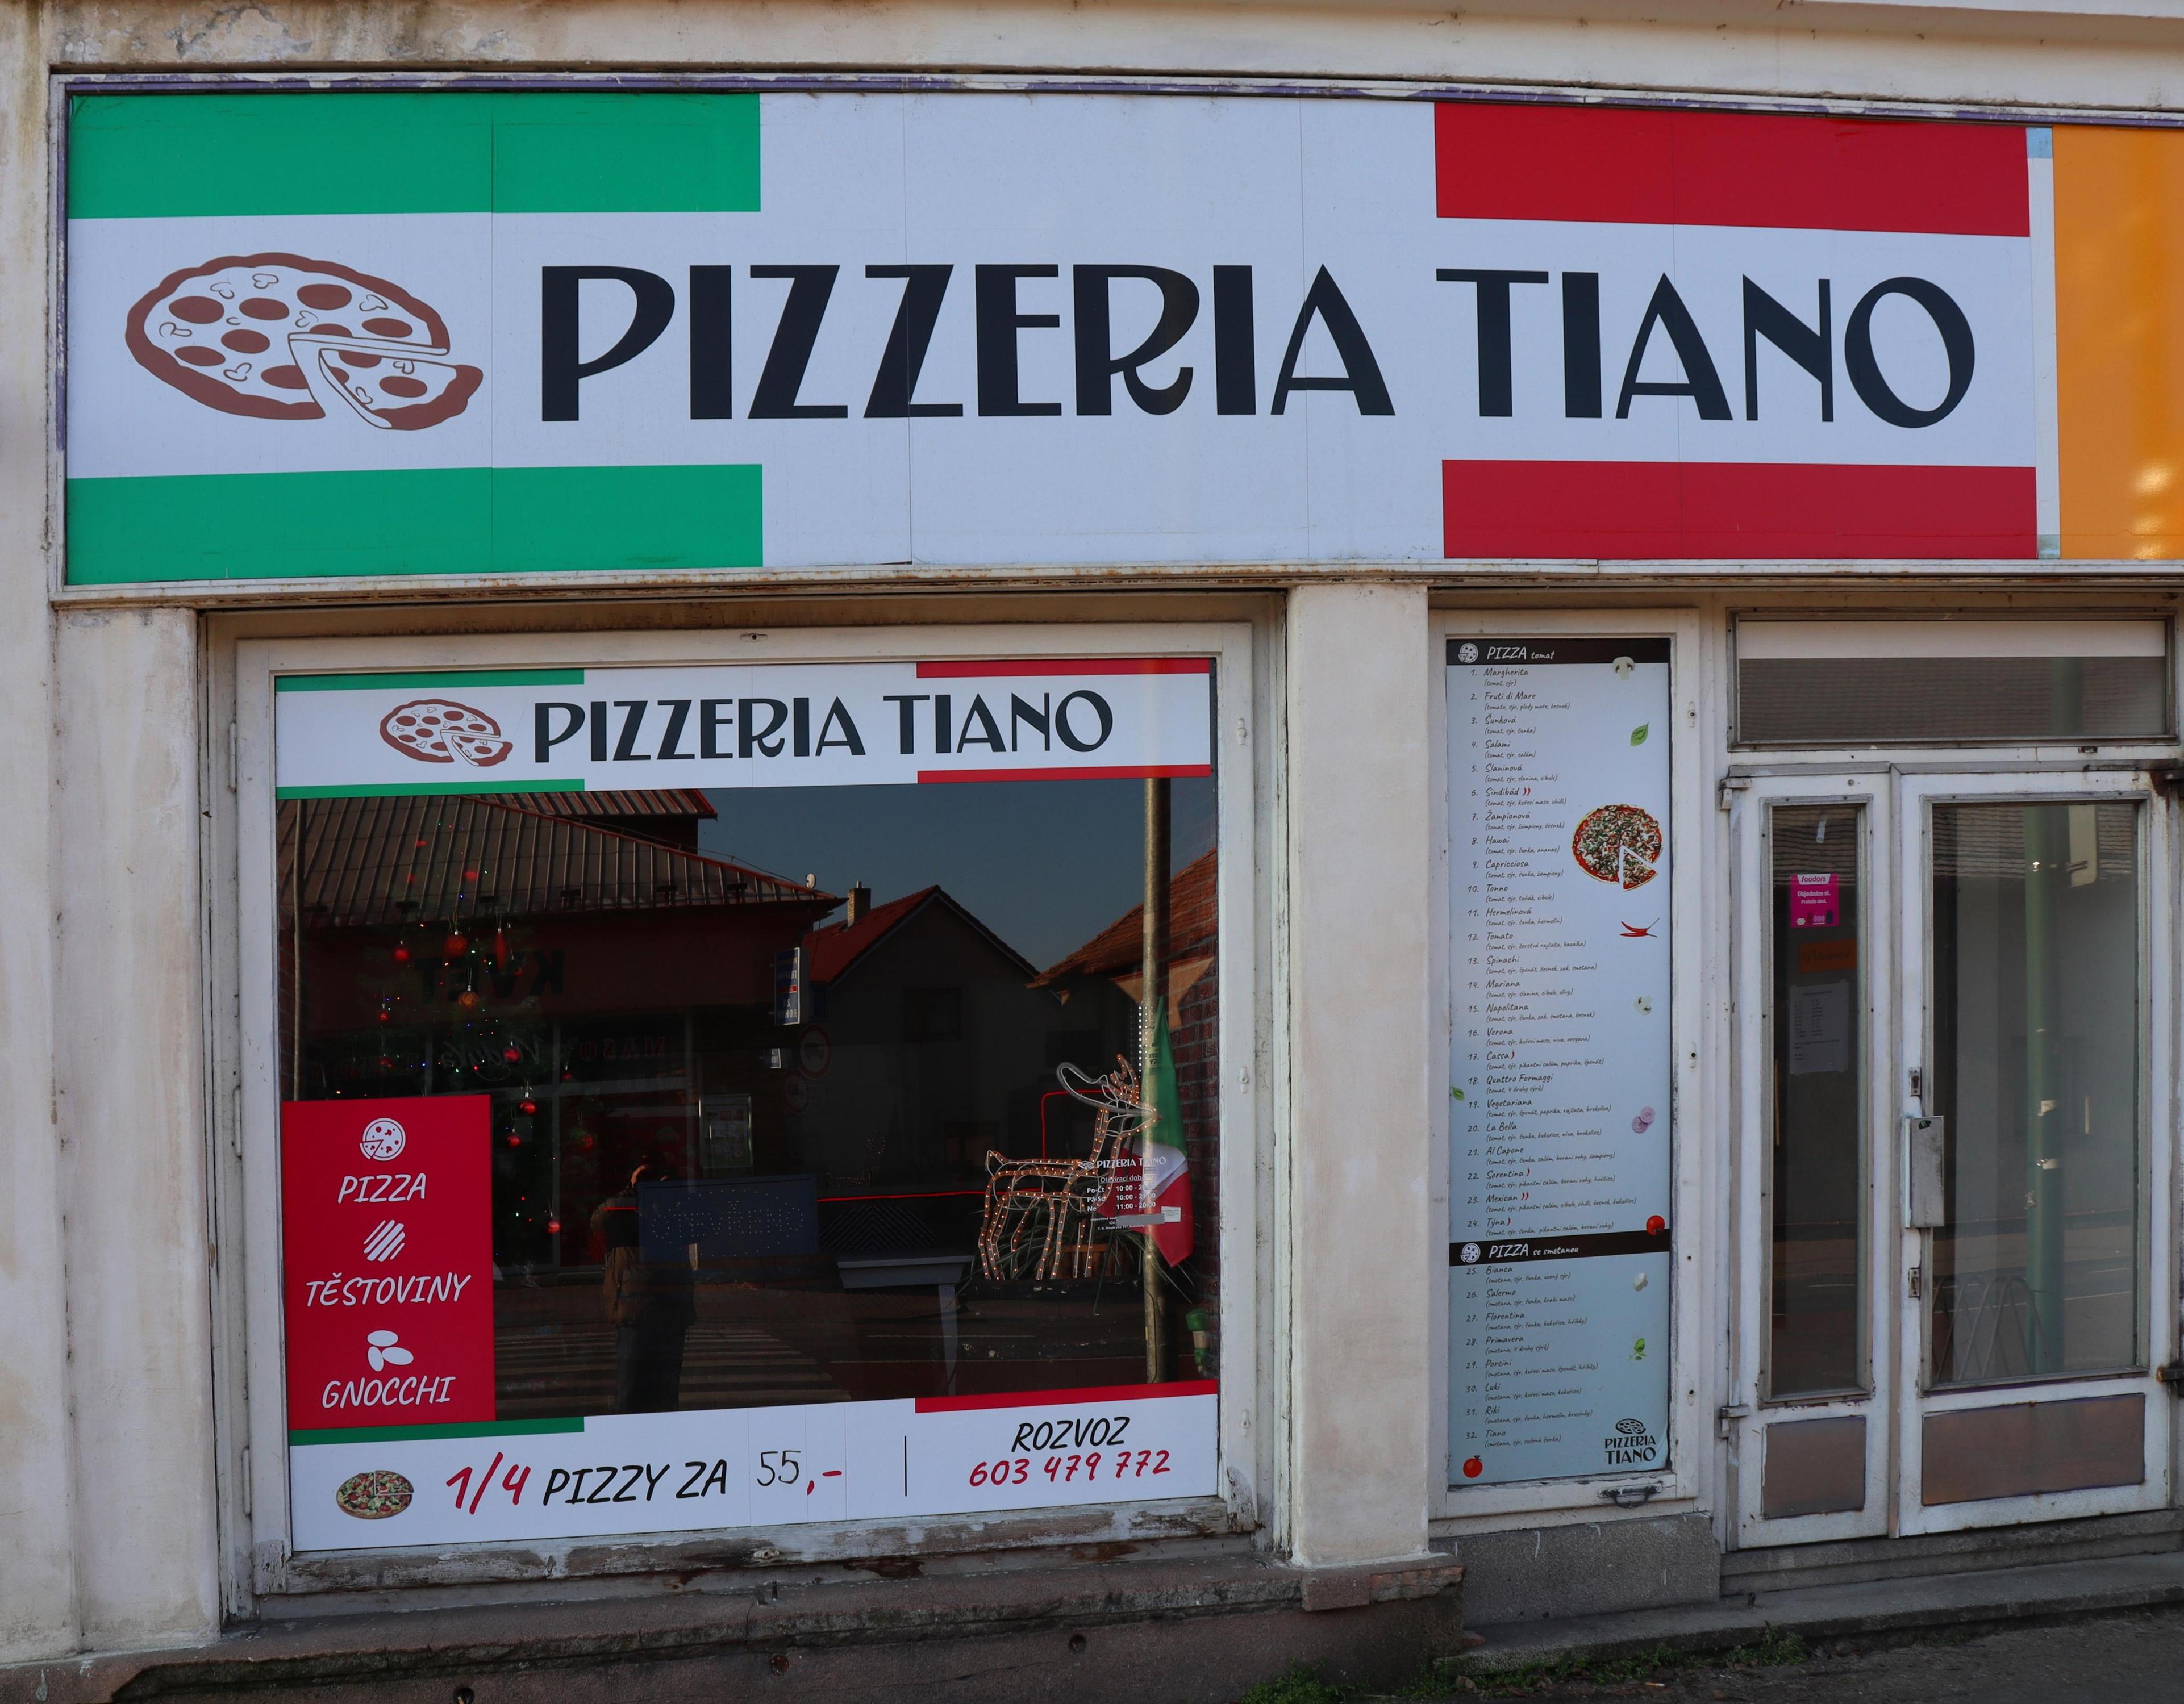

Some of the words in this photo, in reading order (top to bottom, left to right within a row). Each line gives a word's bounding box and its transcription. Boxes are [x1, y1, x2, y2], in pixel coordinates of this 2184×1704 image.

[542, 264, 1395, 421] PIZZERIA
[1436, 269, 1974, 428] TIANO
[1487, 647, 1526, 659] PIZZA
[1483, 668, 1529, 678] Margherita
[1506, 691, 1513, 700] di
[1514, 691, 1536, 700] Mare
[1485, 713, 1516, 725] Šunková
[535, 696, 865, 762] PIZZERIA
[883, 690, 1112, 754] TIANO
[1485, 739, 1511, 749] Salami
[1485, 763, 1523, 772] Slaninová
[1486, 787, 1519, 797] Sindibád
[1485, 810, 1531, 822] Žampionová
[1486, 835, 1510, 845] Hawai
[1486, 859, 1529, 871] Capricciosa
[1487, 884, 1508, 892] Tonno
[1486, 907, 1532, 917] Hermelínová
[1487, 932, 1513, 941] Tomato
[1486, 955, 1520, 966] Spinachi
[1486, 979, 1520, 988] Mariana
[1486, 1003, 1529, 1014] Napolitana
[1487, 1027, 1514, 1037] Verona
[1486, 1051, 1509, 1060] Cassa
[1486, 1075, 1516, 1085] Quattro
[1519, 1074, 1553, 1083] Formaggi
[1487, 1099, 1532, 1109] Vegetariana
[1486, 1122, 1496, 1132] La
[1499, 1122, 1517, 1131] Bella
[1486, 1146, 1495, 1155] Al
[1497, 1146, 1524, 1155] Capone
[1097, 1158, 1136, 1168] PIZZERIA
[1486, 1170, 1524, 1180] Sorentina
[338, 1173, 426, 1203] PIZZA
[1486, 1193, 1518, 1203] Mexican
[1487, 1218, 1505, 1229] Týna
[1489, 1243, 1528, 1258] PIZZA
[1486, 1266, 1512, 1275] Bianca
[307, 1272, 471, 1306] TĚSTOVINY
[1486, 1312, 1525, 1321] Florentina
[1486, 1336, 1524, 1345] Primavera
[1485, 1359, 1512, 1368] Porcini
[323, 1376, 456, 1408] GNOCCHI
[1485, 1383, 1501, 1392] Luki
[1485, 1405, 1500, 1415] Riki
[1011, 1417, 1131, 1452] ROZVOZ
[1486, 1430, 1506, 1438] Tiano
[1605, 1435, 1656, 1448] PIZZERIA
[1605, 1447, 1656, 1464] TIANO
[970, 1459, 1030, 1486] 603
[1044, 1453, 1101, 1481] 479
[1116, 1450, 1170, 1478] 772
[446, 1452, 531, 1514] 1/4
[543, 1464, 670, 1506] PIZZY
[676, 1459, 727, 1498] ZA
